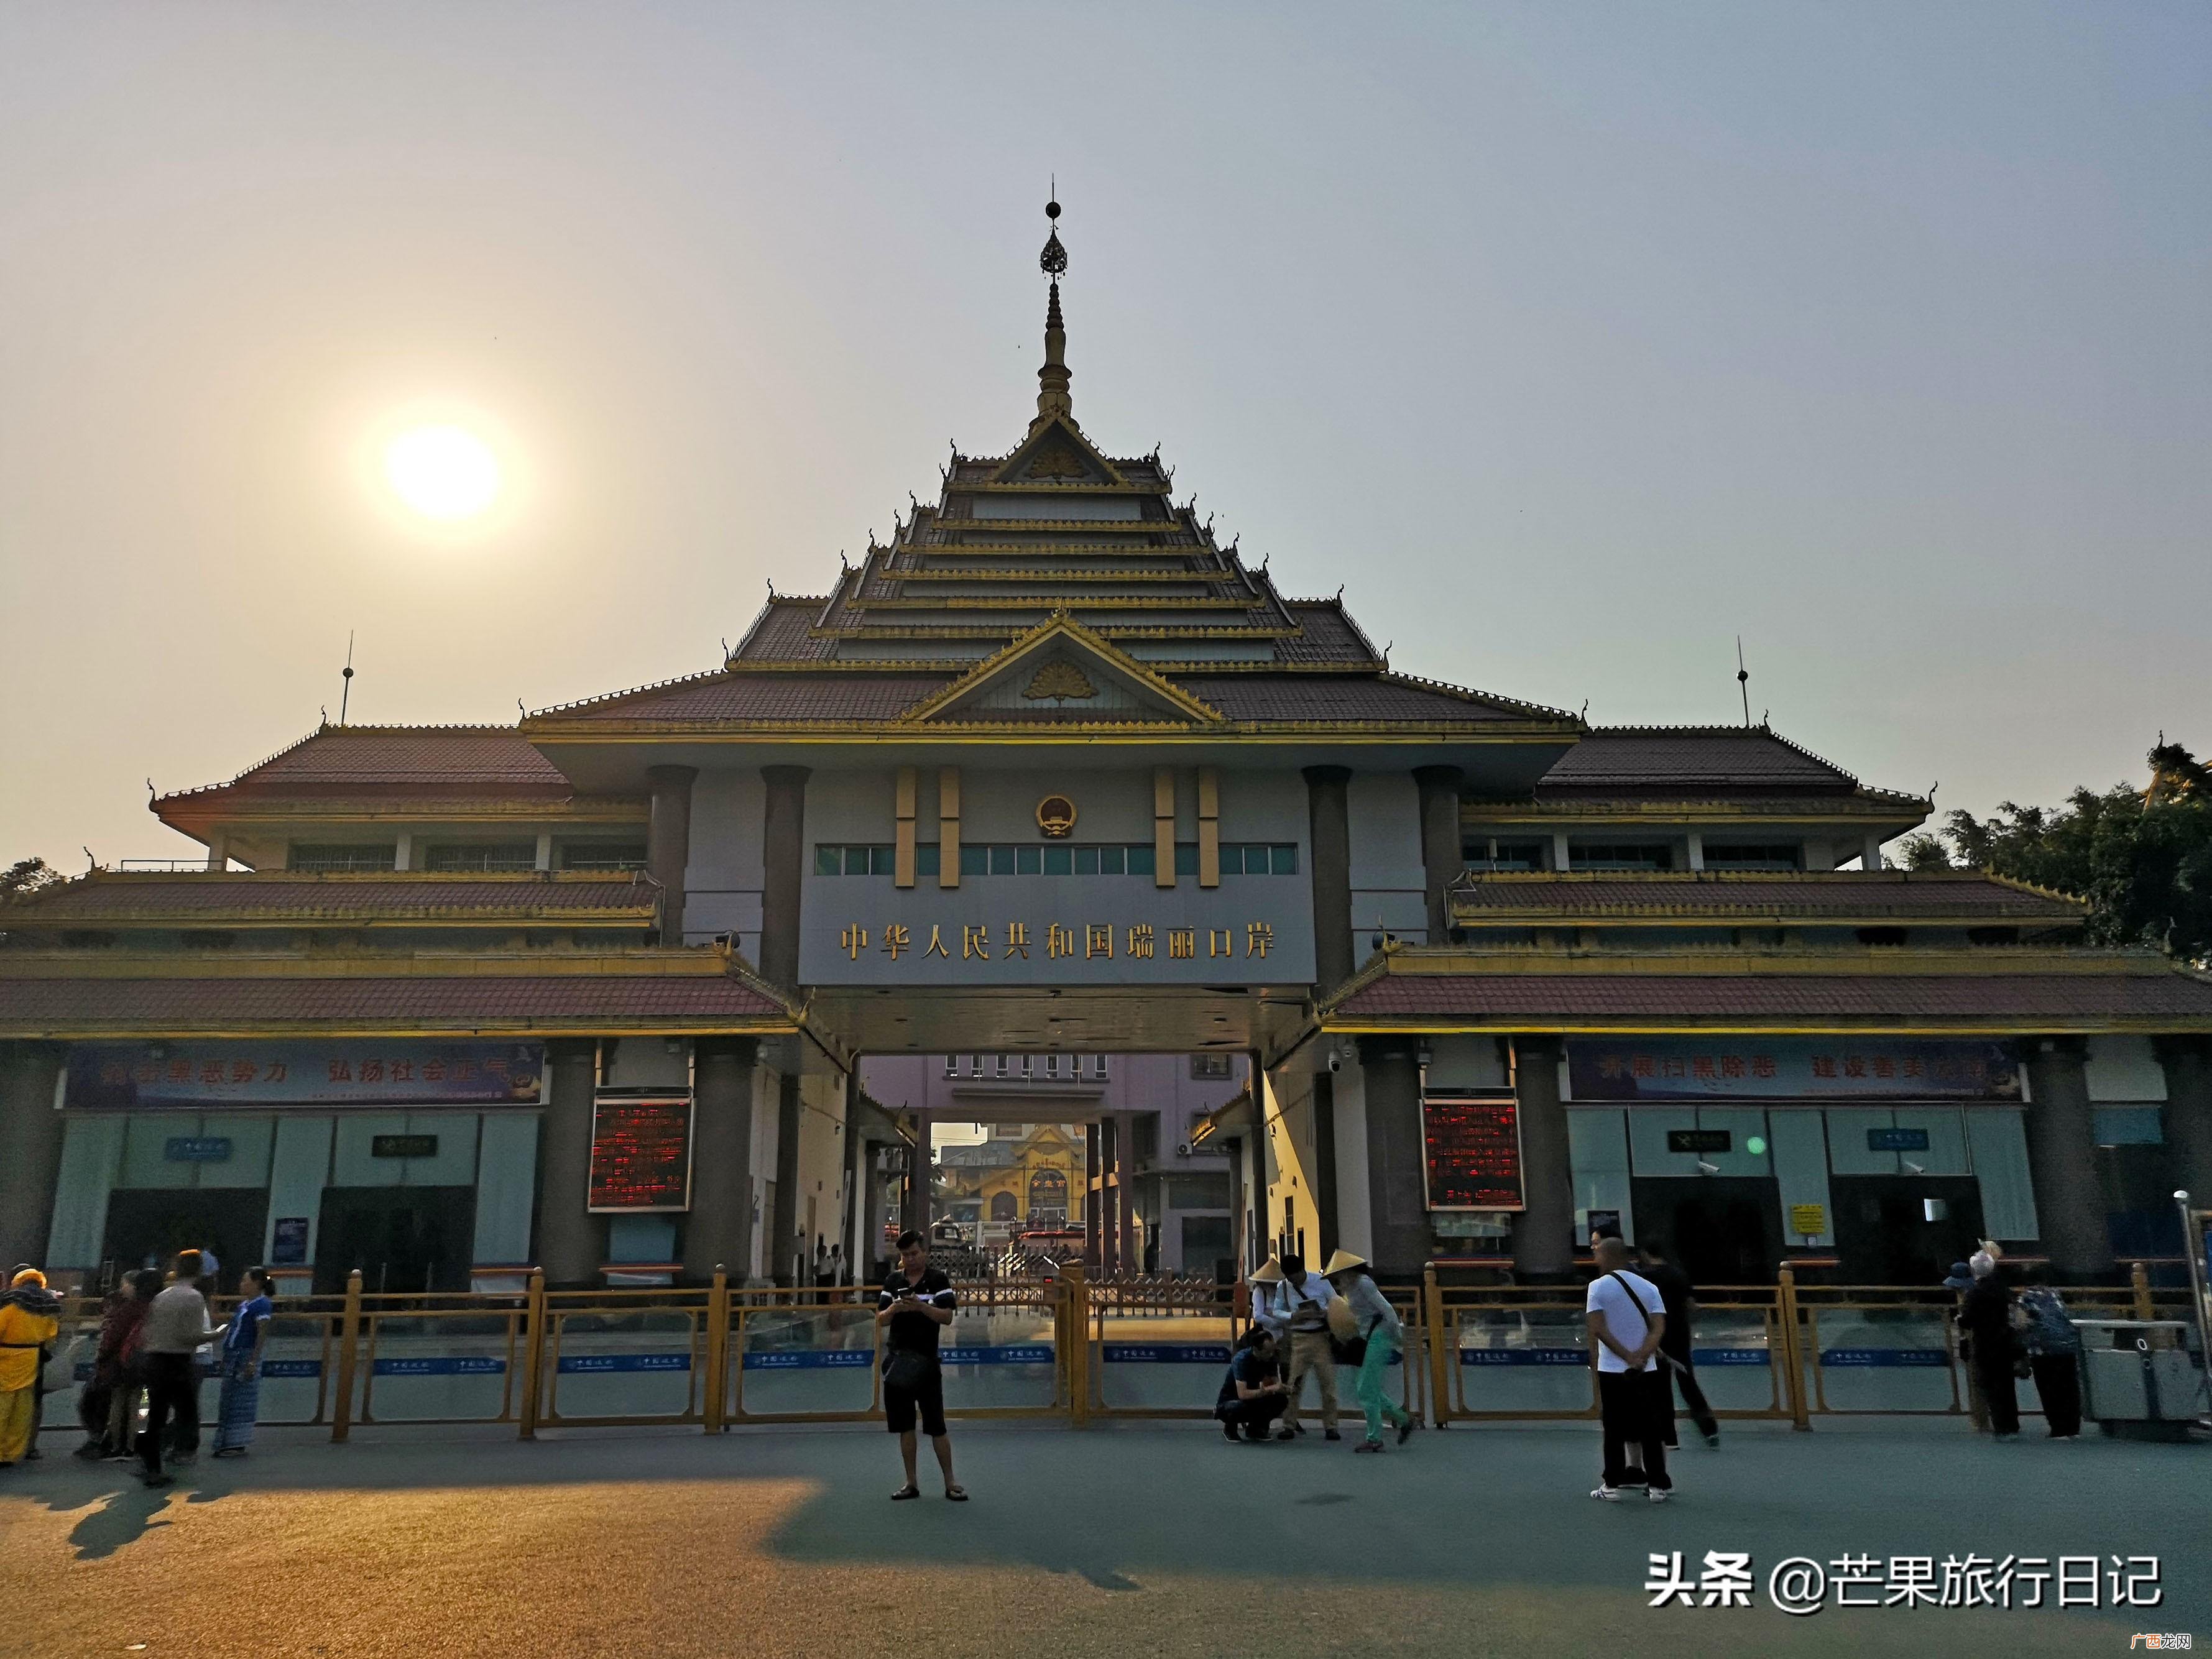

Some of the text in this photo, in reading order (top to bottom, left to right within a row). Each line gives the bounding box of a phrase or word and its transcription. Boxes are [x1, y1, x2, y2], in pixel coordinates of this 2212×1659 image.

[841, 922, 1274, 960] 中华人民共和国瑞丽口岸
[329, 1058, 512, 1083] 弘扬社会正气
[1600, 1055, 1777, 1079] 开展扫黑除恶
